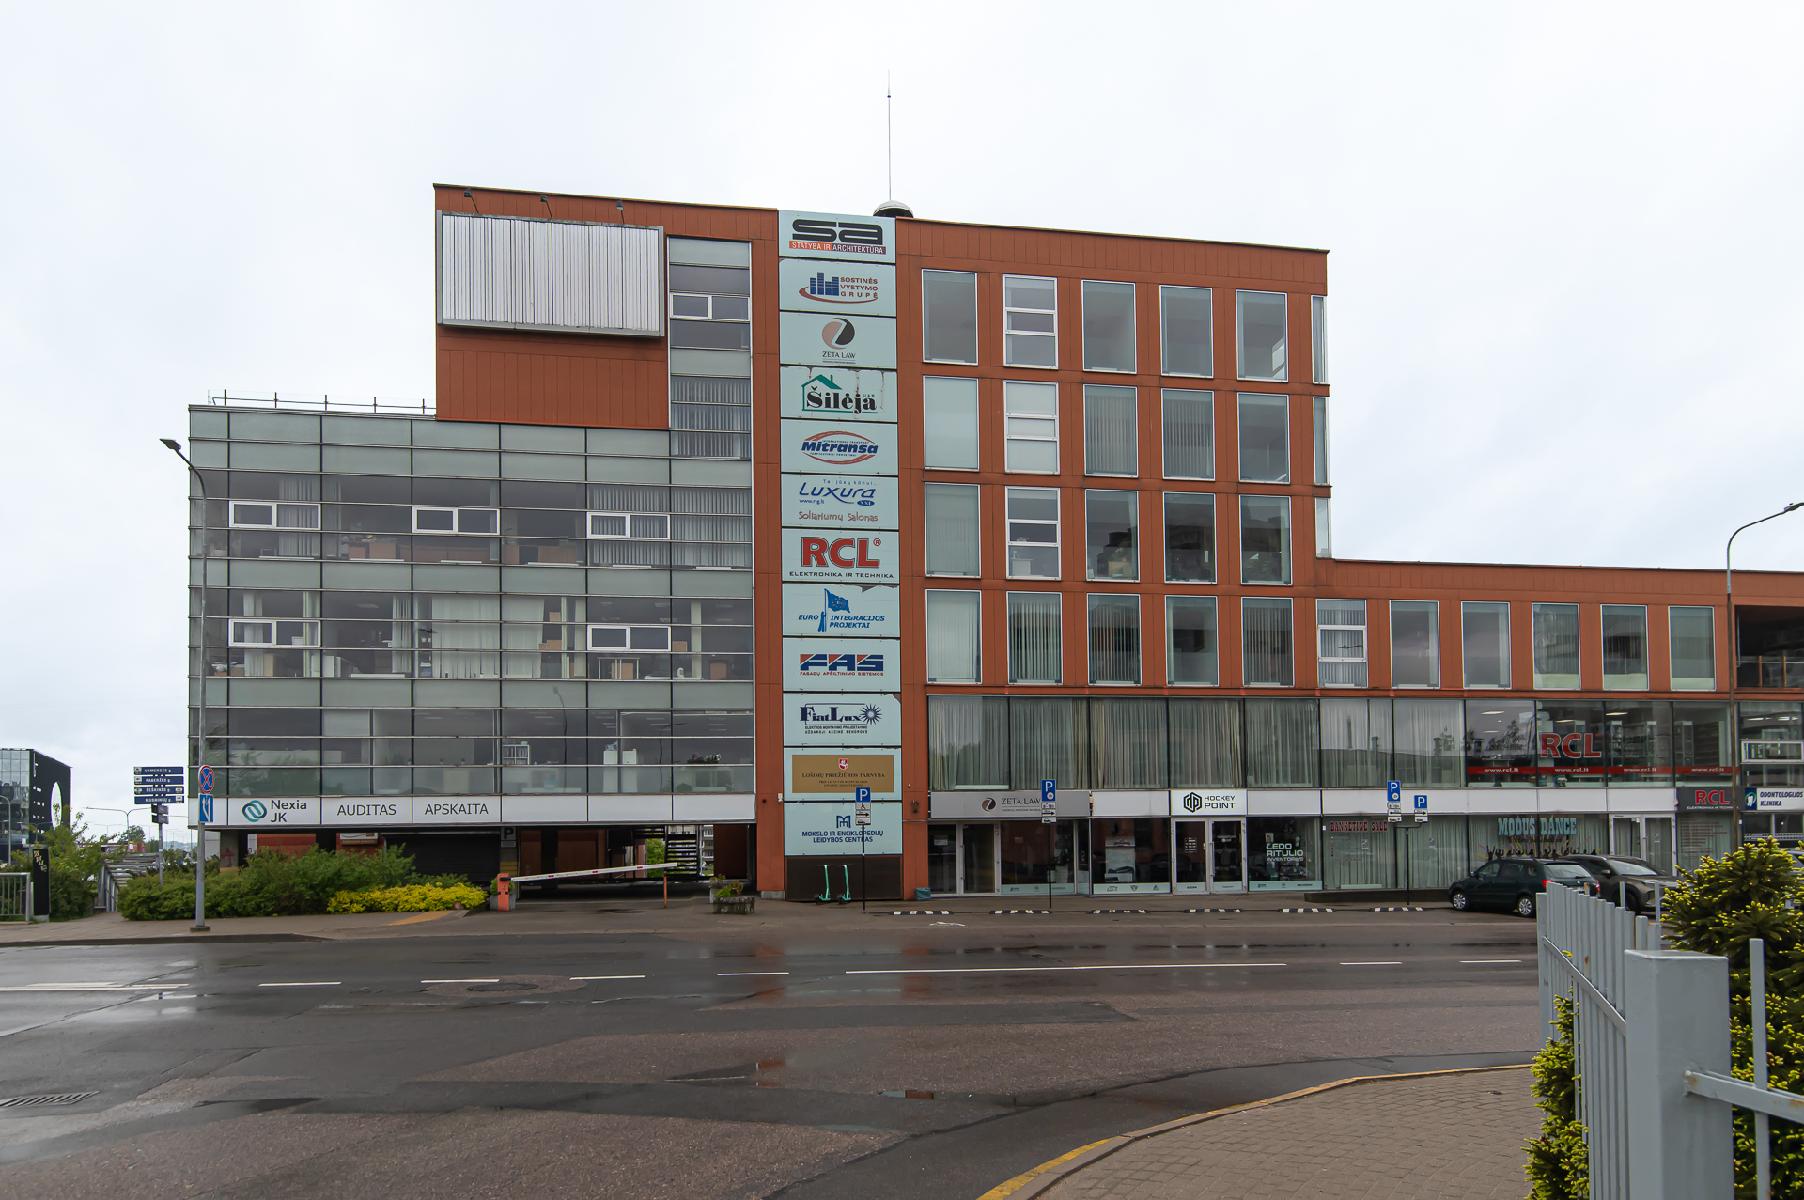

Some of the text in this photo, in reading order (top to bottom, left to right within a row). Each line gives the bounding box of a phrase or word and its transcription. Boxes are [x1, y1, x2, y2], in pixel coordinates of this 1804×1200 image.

[840, 276, 878, 285] SOSTINĖS
[840, 291, 879, 299] GRUPĖ
[822, 350, 856, 359] ZETA LAW
[806, 385, 877, 414] Šilėja
[801, 441, 879, 454] Mitransa
[799, 482, 876, 505] Luxura
[847, 511, 879, 522] Salonas
[800, 537, 881, 568] RCL
[1539, 732, 1602, 758] RCL
[1045, 781, 1053, 792] P
[1390, 782, 1398, 792] P
[860, 788, 868, 801] P
[1695, 789, 1731, 805] RCL
[271, 800, 307, 810] Nexia
[1417, 796, 1425, 808] P
[337, 803, 489, 816] AUDITAS APSKAITA
[271, 812, 287, 823] JK
[1498, 817, 1577, 835] MODUS DANCE
